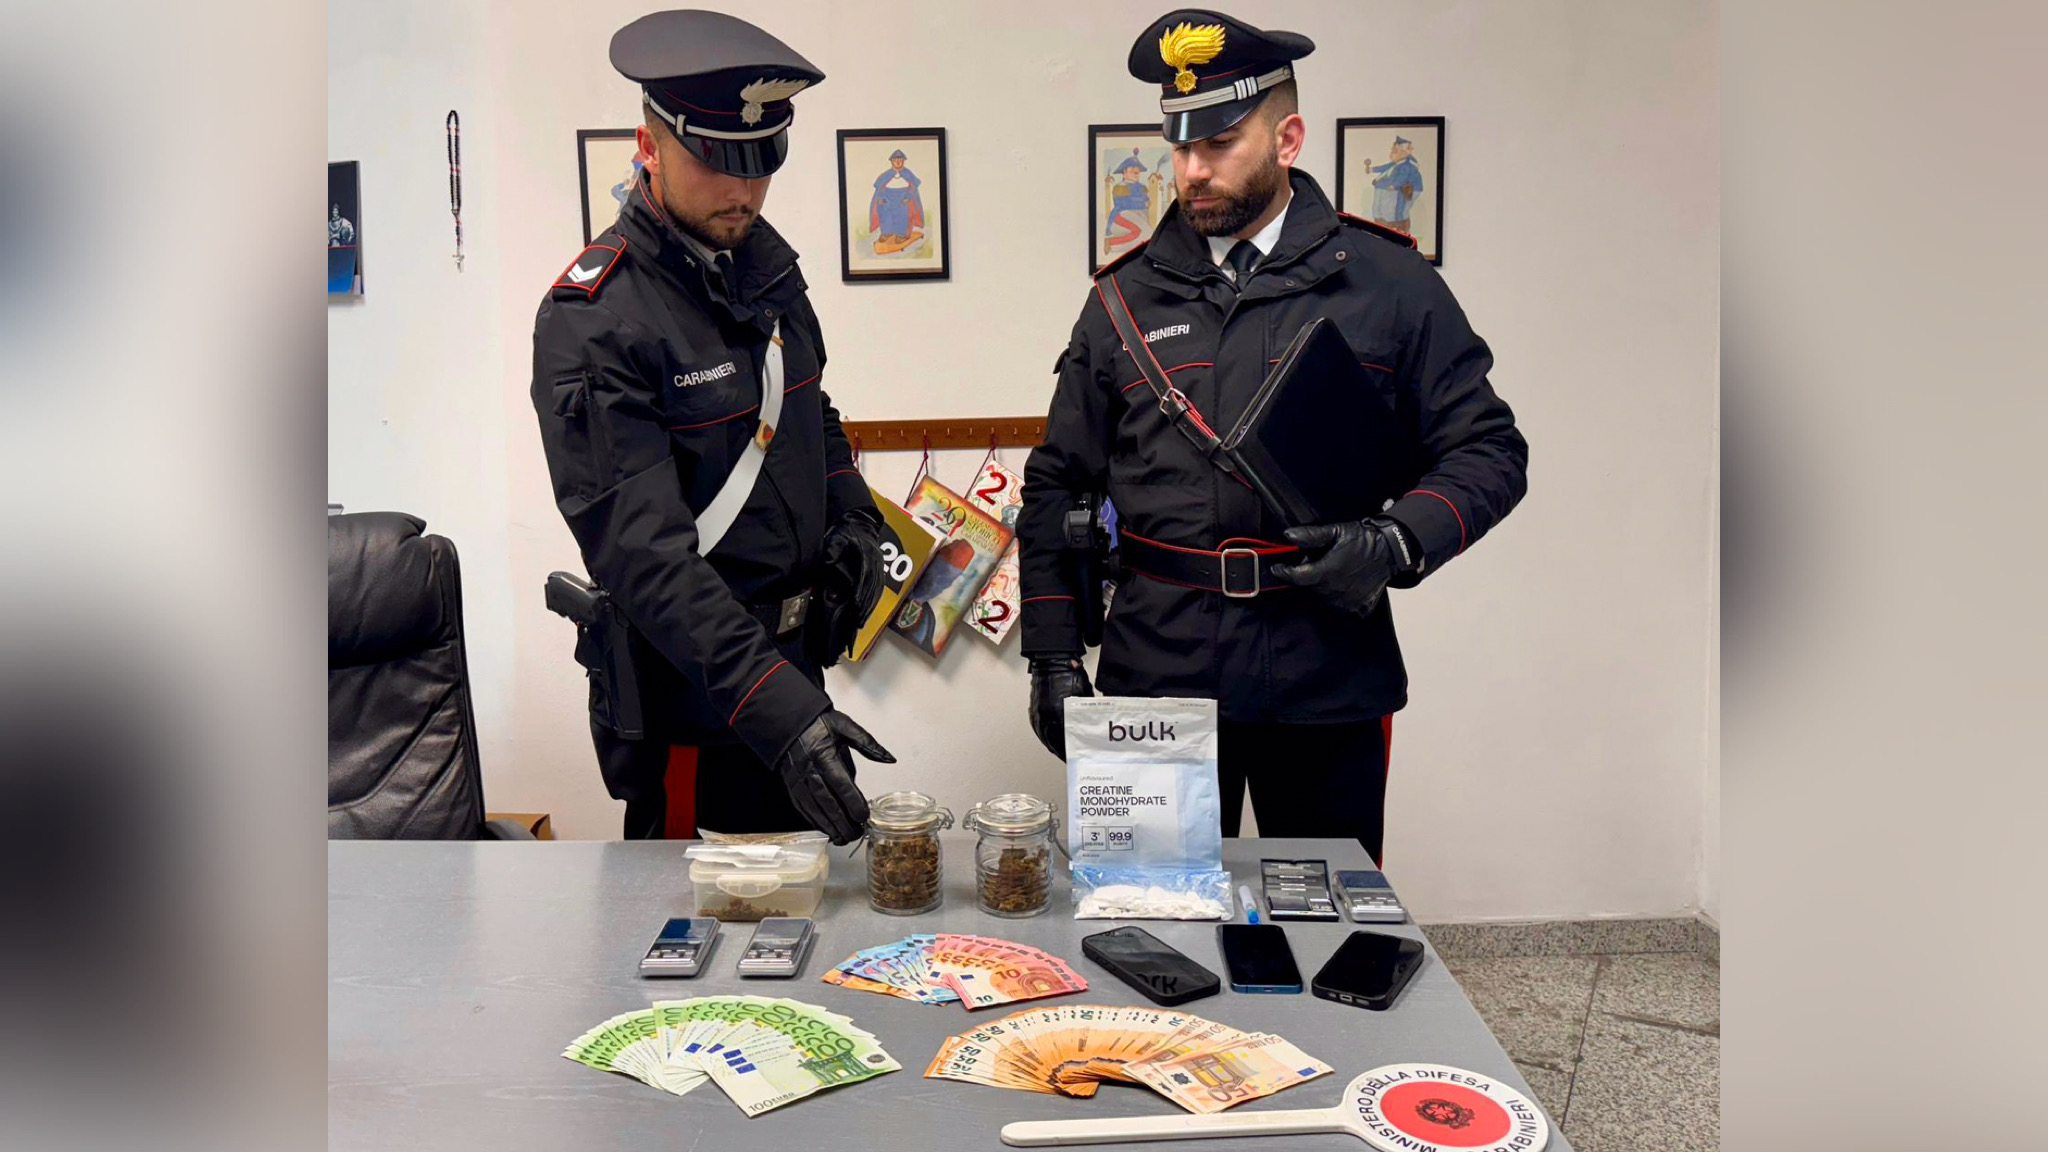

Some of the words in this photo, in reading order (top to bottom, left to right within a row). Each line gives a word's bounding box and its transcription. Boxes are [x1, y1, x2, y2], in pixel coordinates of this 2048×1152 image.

[1122, 324, 1190, 351] CABINIERI
[976, 472, 1007, 506] 2
[978, 600, 1011, 635] 2
[1108, 721, 1176, 742] bulk
[1079, 785, 1133, 796] CREATINE
[1079, 796, 1167, 806] MONOHYDRATE
[1080, 807, 1130, 816] POWDER
[1109, 832, 1132, 841] 99.9
[995, 968, 1021, 980] 10
[975, 994, 993, 1004] 10
[985, 1025, 1005, 1035] 50
[970, 1032, 991, 1042] 50
[805, 1037, 855, 1060] 100
[959, 1046, 981, 1056] 50
[955, 1055, 977, 1065] 50
[1360, 1070, 1412, 1098] DELLA
[1415, 1070, 1491, 1092] DIFESA
[748, 1099, 774, 1112] 100
